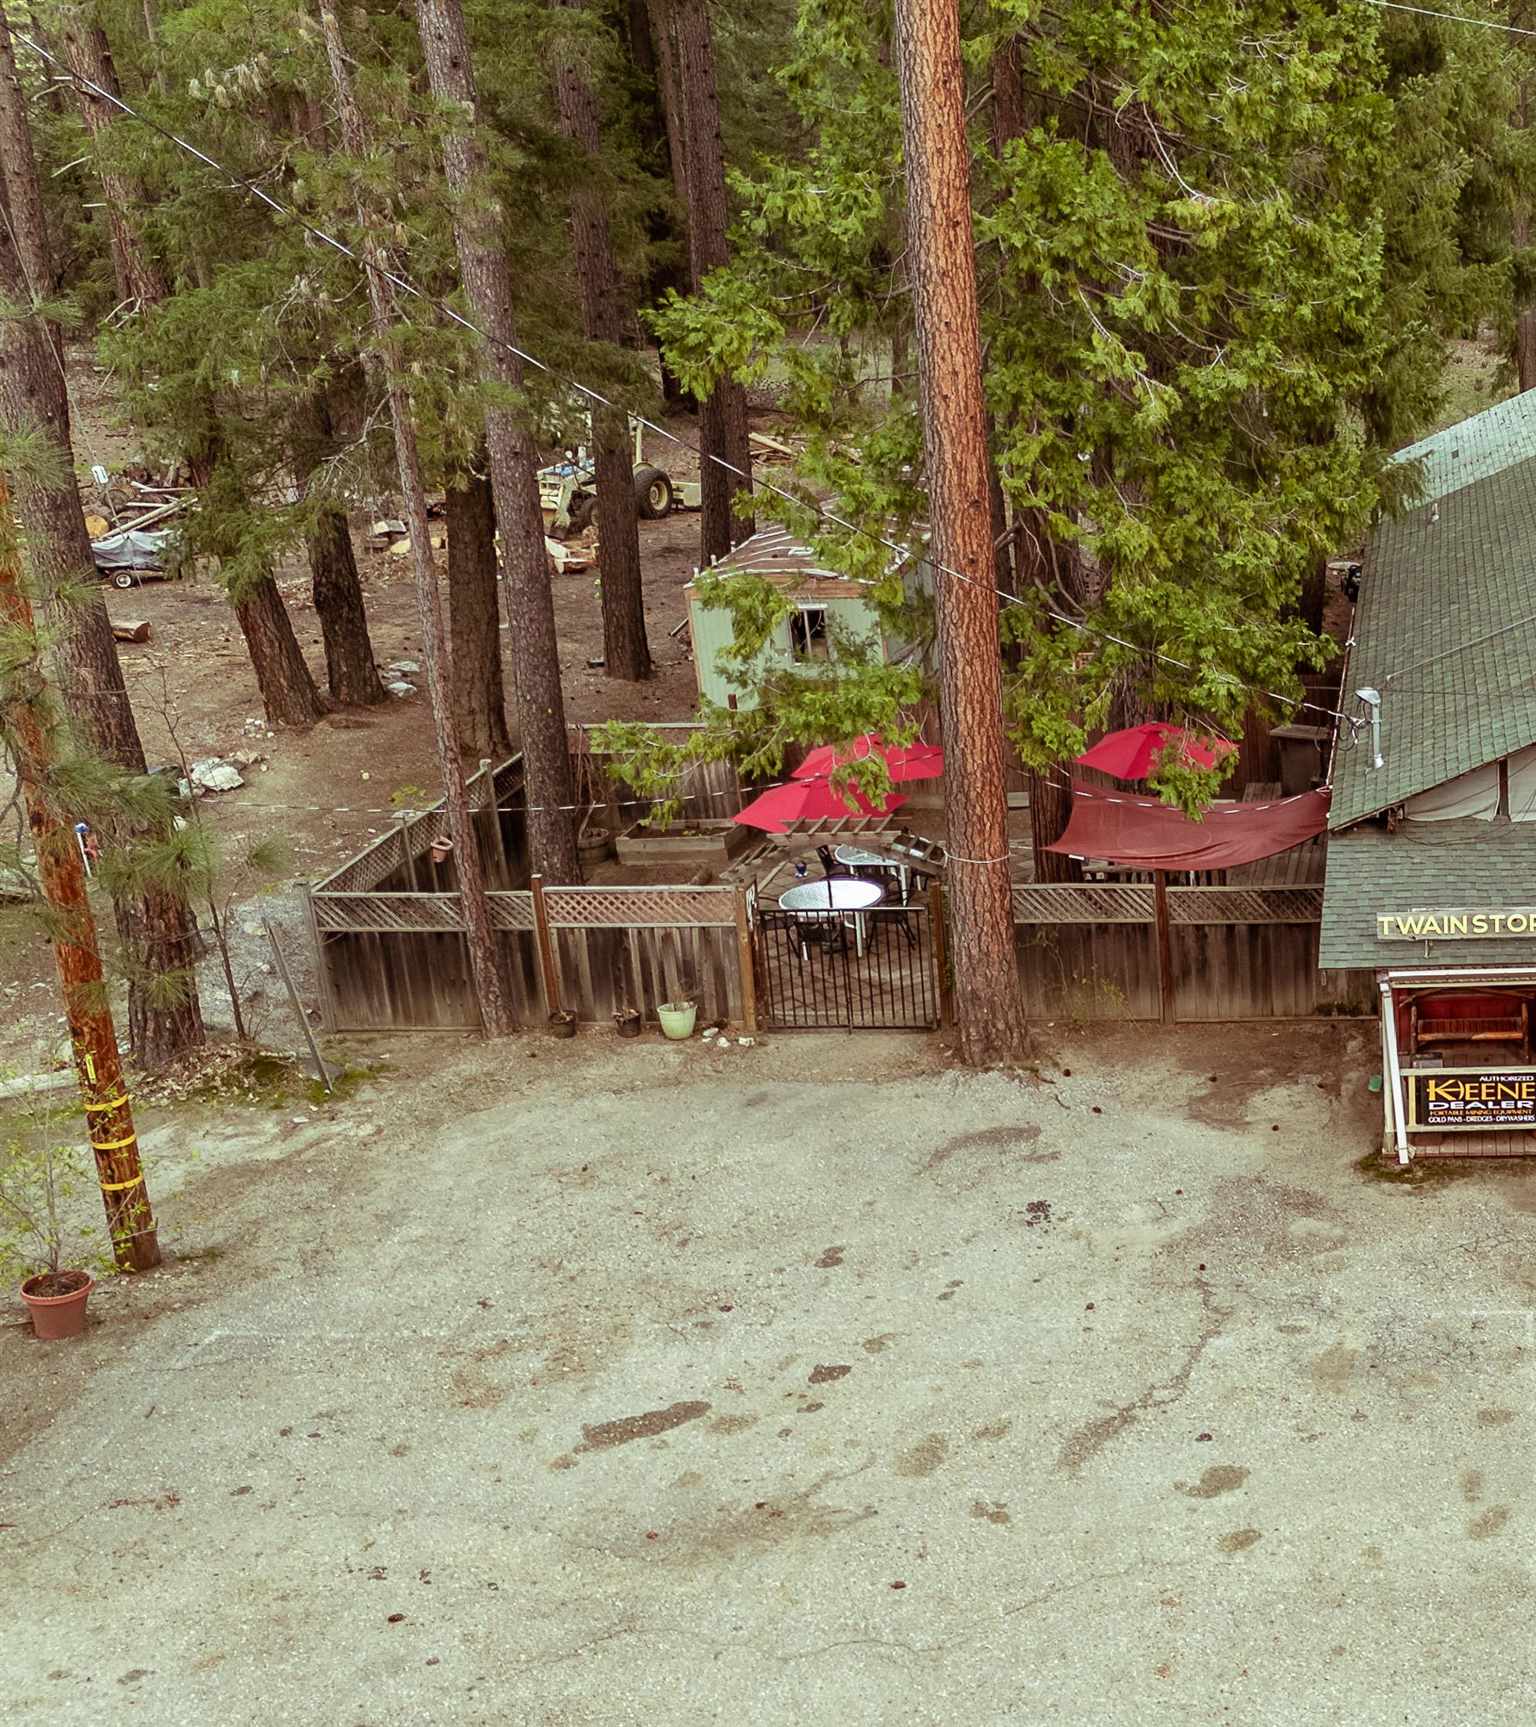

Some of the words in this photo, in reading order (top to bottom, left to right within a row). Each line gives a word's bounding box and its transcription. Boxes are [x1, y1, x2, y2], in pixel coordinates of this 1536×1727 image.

[1378, 914, 1468, 936] TWAIN
[1427, 1079, 1536, 1101] KEENE
[1428, 1100, 1535, 1110] DEALER
